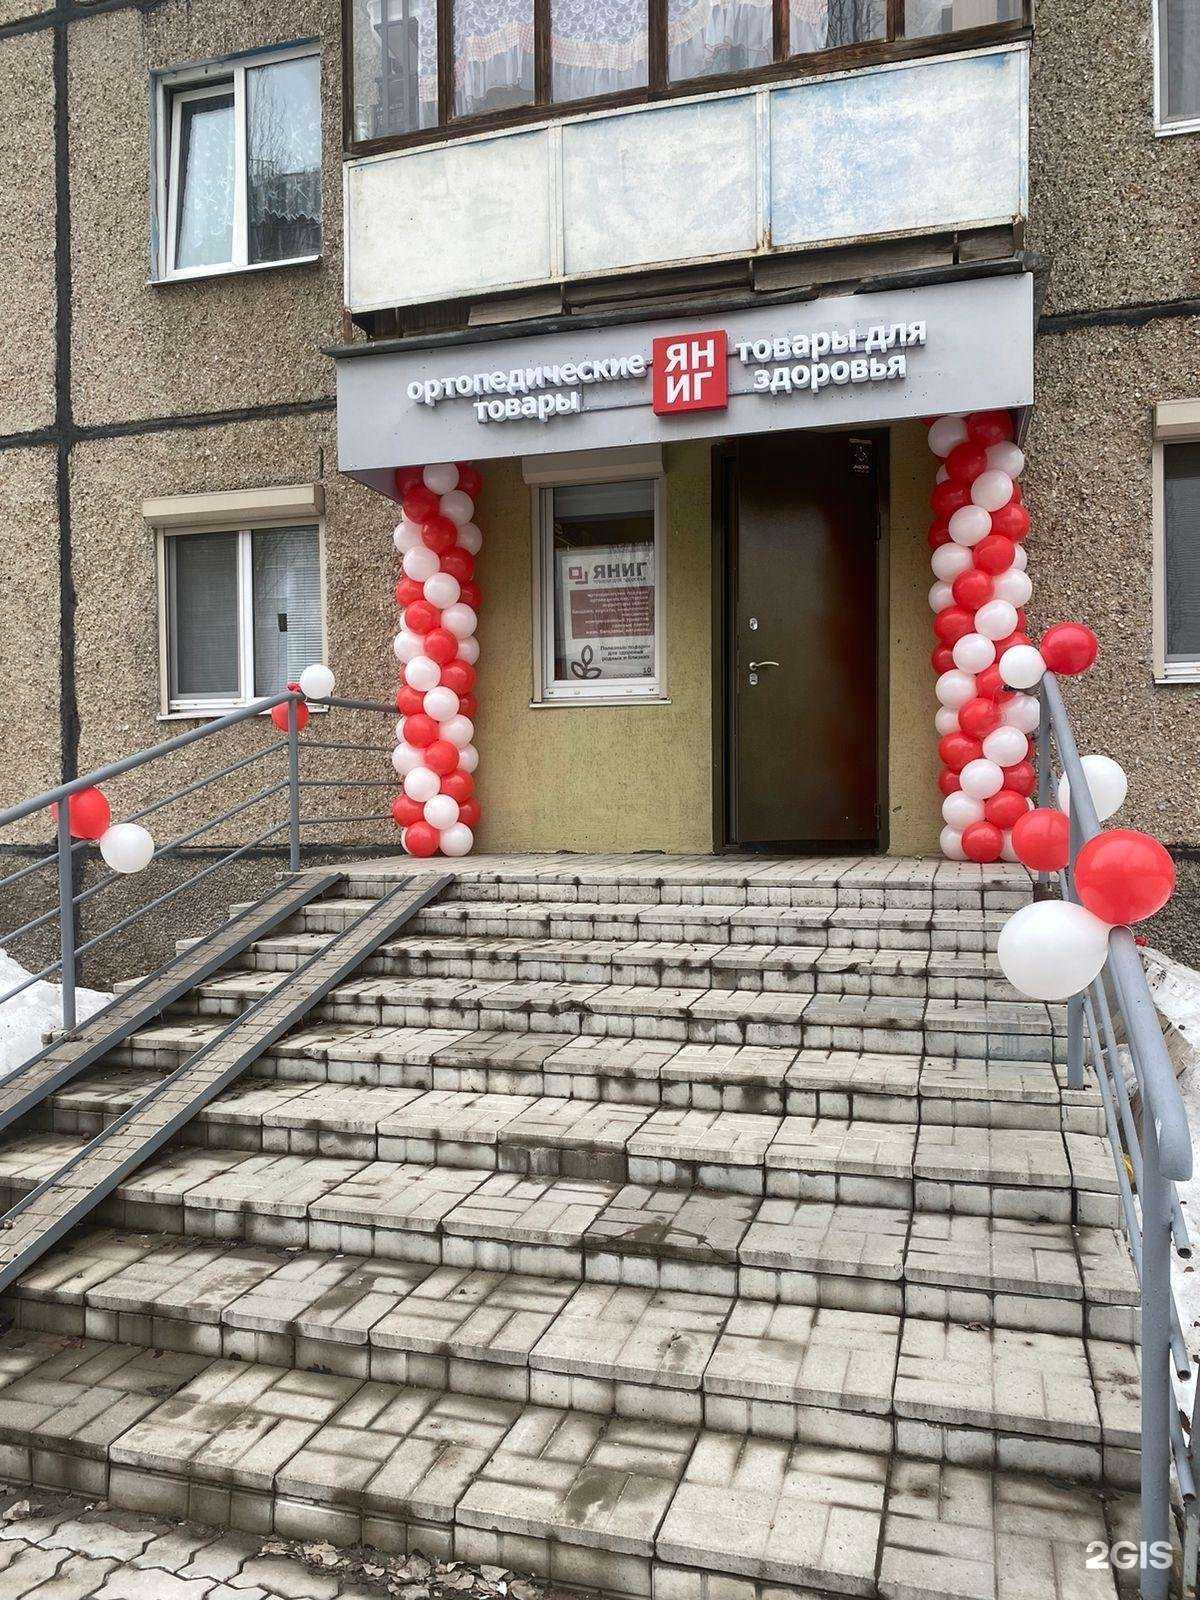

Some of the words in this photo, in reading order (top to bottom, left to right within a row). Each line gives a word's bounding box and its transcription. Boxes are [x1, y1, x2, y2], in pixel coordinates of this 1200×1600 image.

[664, 339, 716, 372] ЯН
[736, 328, 858, 364] товары
[864, 320, 928, 354] для
[406, 354, 648, 407] ортопедические
[666, 371, 712, 404] ИГ
[753, 354, 908, 394] здоровья
[473, 390, 582, 424] товары
[593, 562, 648, 580] ЯНИГ
